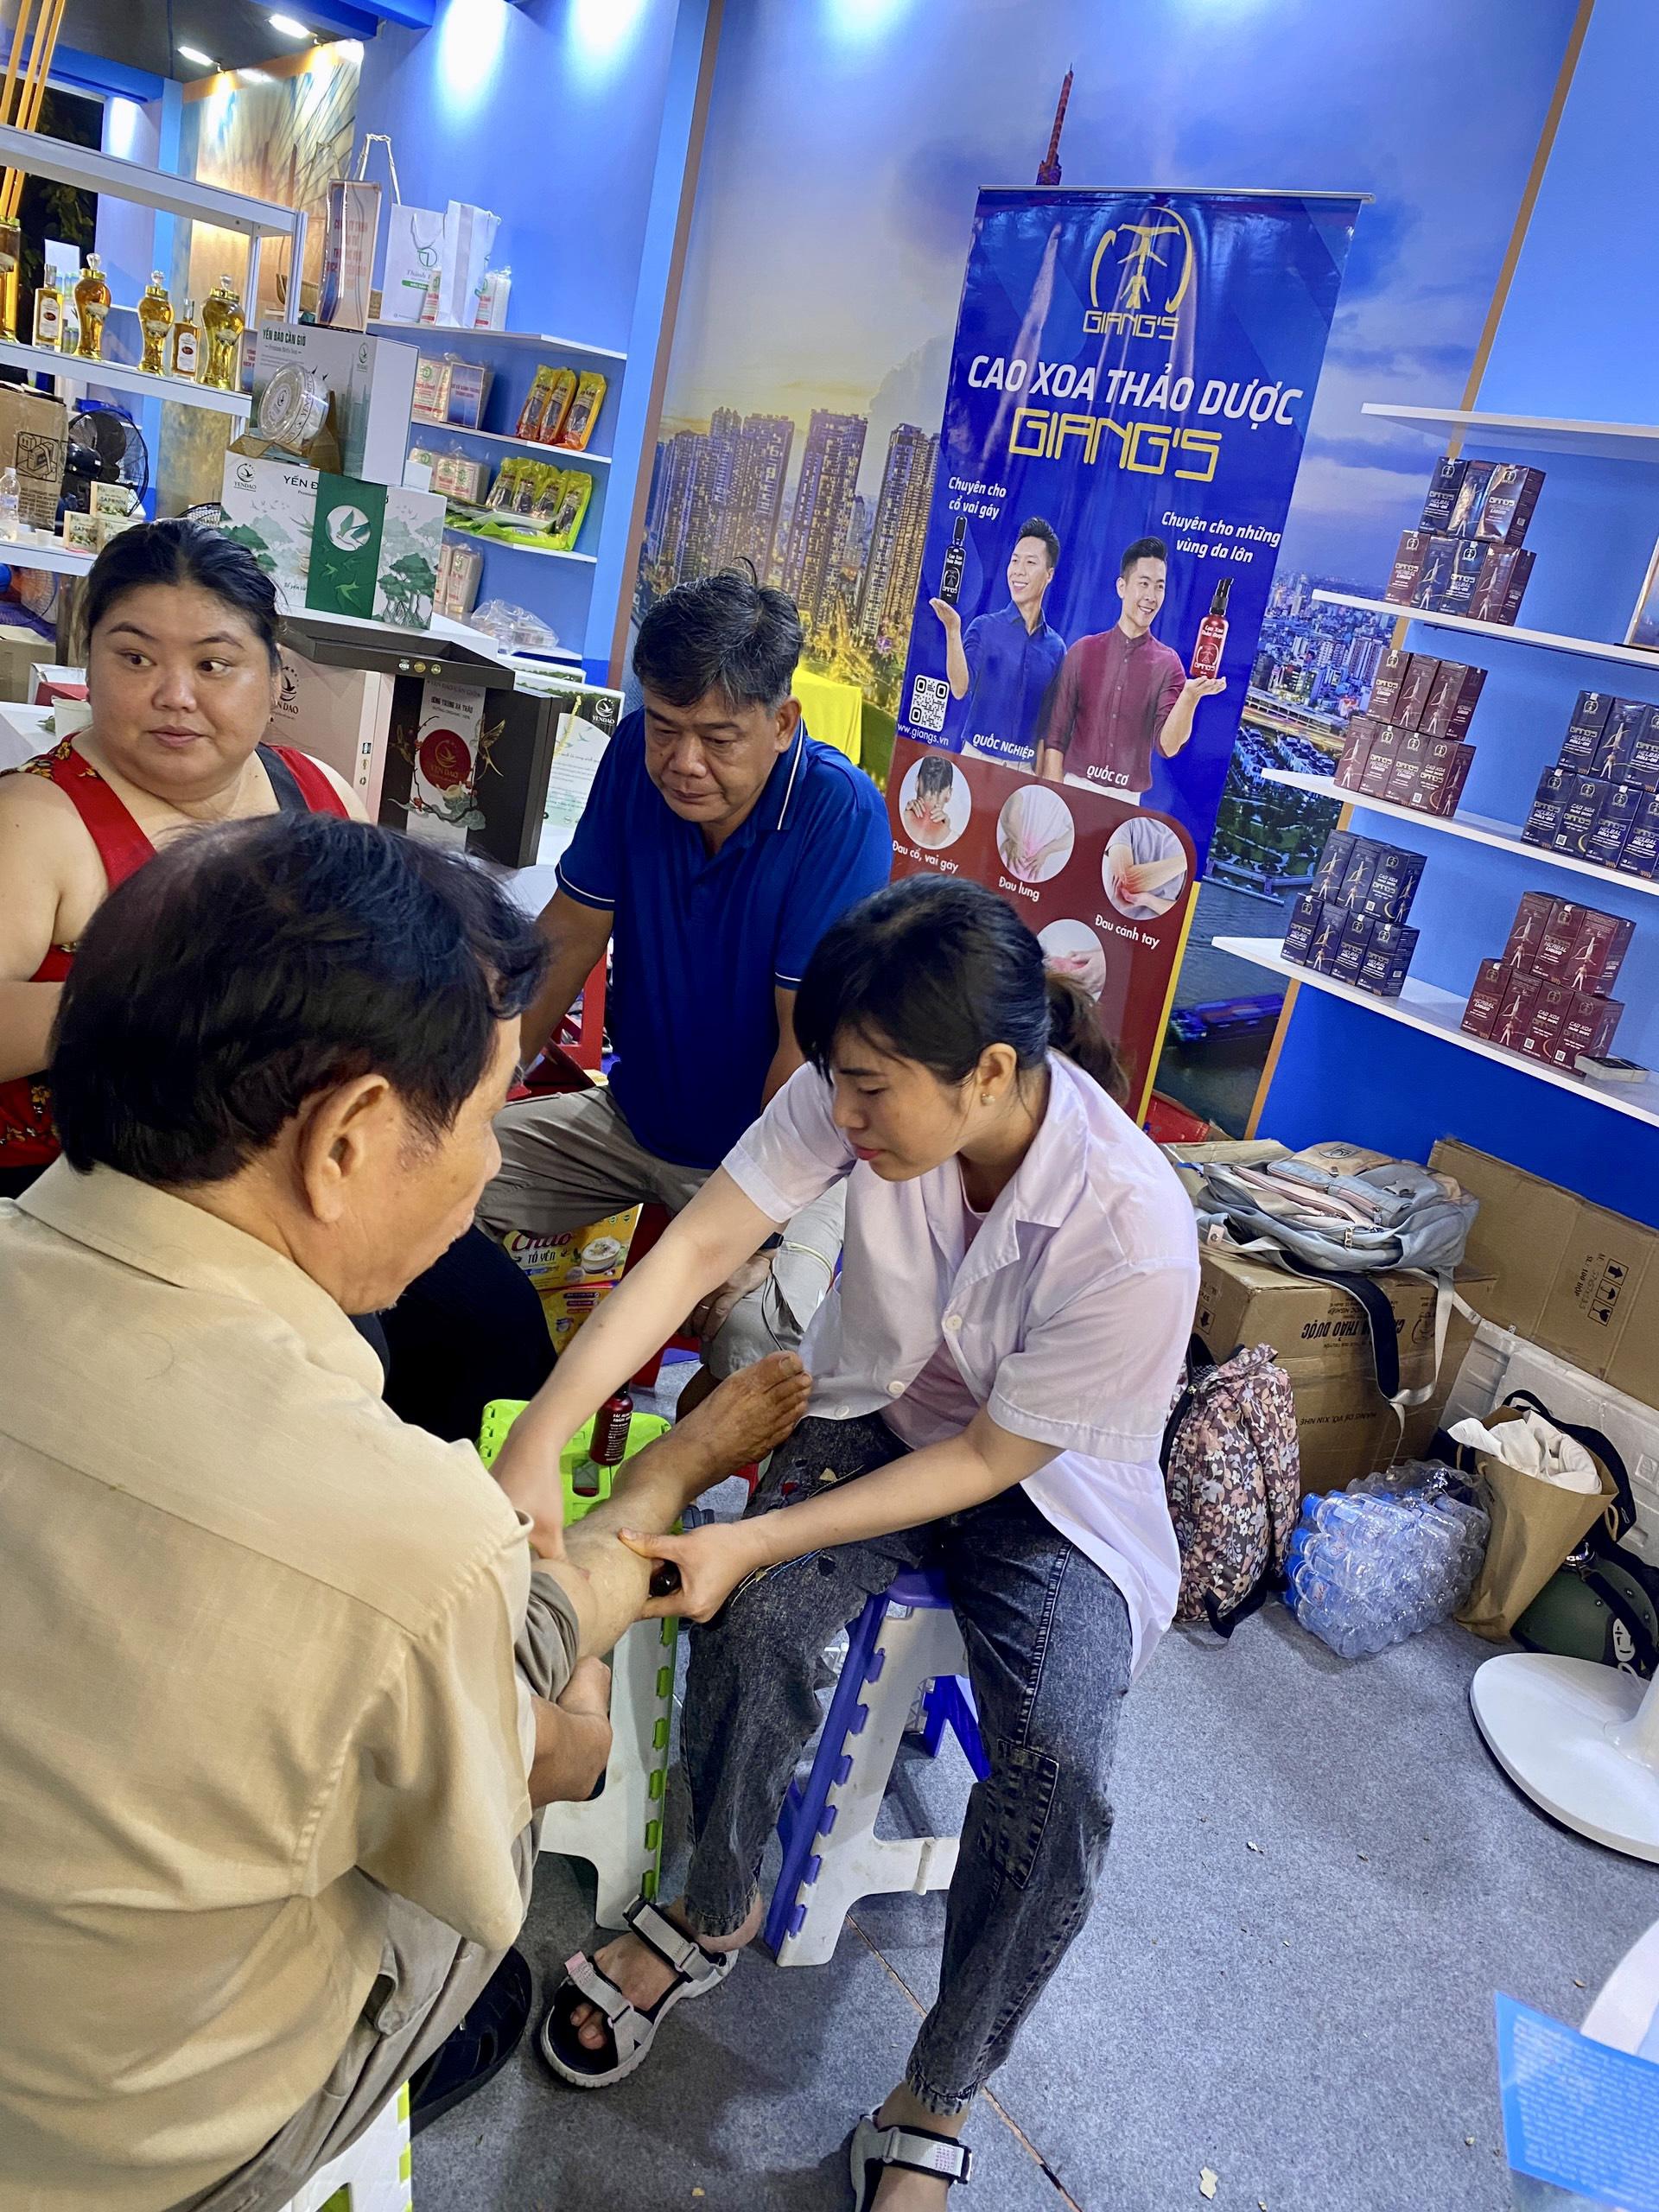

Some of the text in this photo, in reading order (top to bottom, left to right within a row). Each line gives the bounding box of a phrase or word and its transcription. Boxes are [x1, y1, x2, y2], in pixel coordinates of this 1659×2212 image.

[1083, 310, 1179, 340] GIANG'S
[968, 354, 1304, 430] CAO XOA THẢO DƯỢC
[1008, 406, 1223, 482] GIANG'S
[283, 474, 308, 488] YẾN
[948, 476, 1007, 499] Chuyên cho
[948, 494, 1001, 521] cổ vai gáy
[1160, 511, 1281, 548] Chuyên cho những
[1176, 536, 1254, 564] vùng da lớn
[973, 733, 1035, 760] QUỐC NGHIỆP
[1086, 764, 1129, 786] QUỐC CƠ
[892, 839, 908, 858] Đau
[925, 854, 939, 868] vai
[938, 855, 959, 874] gáy
[998, 875, 1018, 893] Đau
[1094, 913, 1161, 949] Đau cánh tay
[1300, 1319, 1360, 1344] THẢO DƯỢC
[1315, 1415, 1331, 1425] XIN
